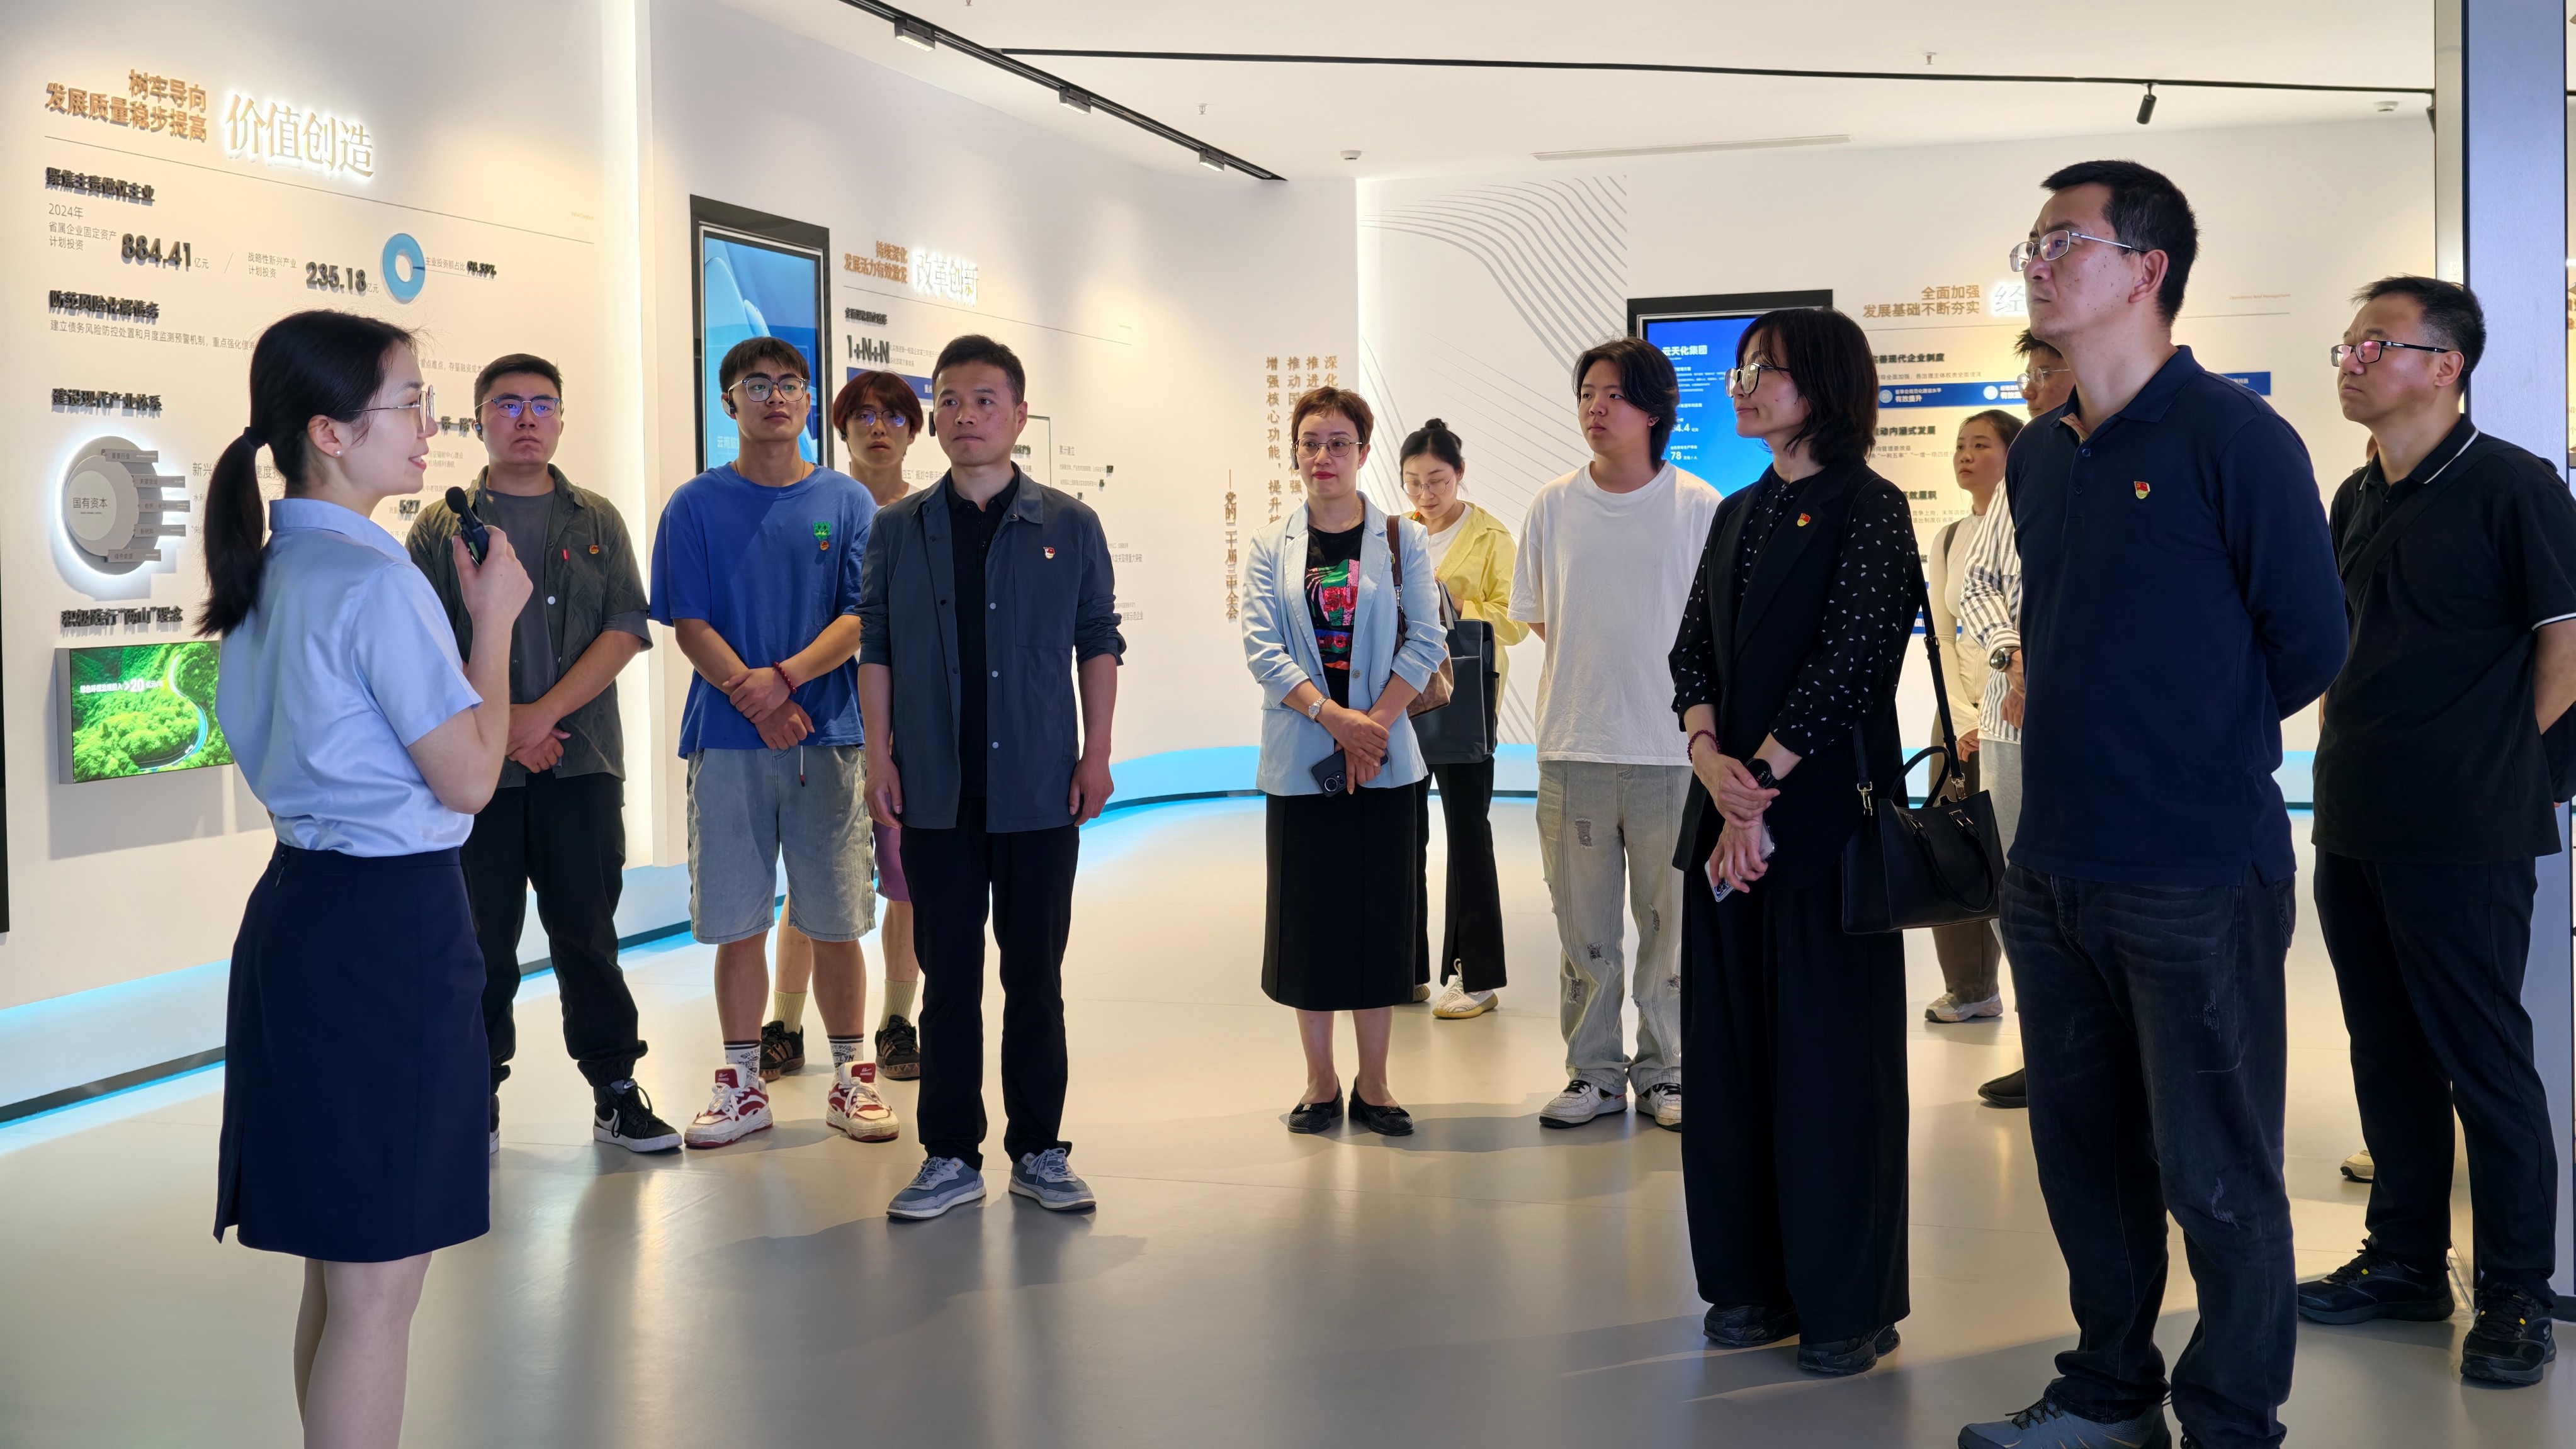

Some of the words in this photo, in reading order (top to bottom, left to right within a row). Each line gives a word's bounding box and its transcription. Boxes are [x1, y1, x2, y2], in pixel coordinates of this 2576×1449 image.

[128, 69, 207, 111] 树牢导向
[46, 82, 207, 142] 发展质量稳步提高
[225, 94, 373, 178] 价值创造
[48, 203, 84, 220] 2024年
[48, 222, 117, 240] 省属企业固定资产
[49, 237, 84, 251] 计划投资
[121, 233, 191, 267] 884.41
[195, 257, 209, 269] 亿元
[247, 252, 297, 269] 战略性新兴产业
[248, 266, 277, 279] 计划投资
[306, 261, 367, 291] 235.18
[915, 252, 980, 302] 改革创新
[1921, 285, 1980, 300] 全面加强
[1863, 300, 1980, 319] 发展基础不断夯实
[847, 334, 890, 364] 1+N+N
[1670, 451, 1682, 460] 78
[73, 497, 108, 510] 国有资本
